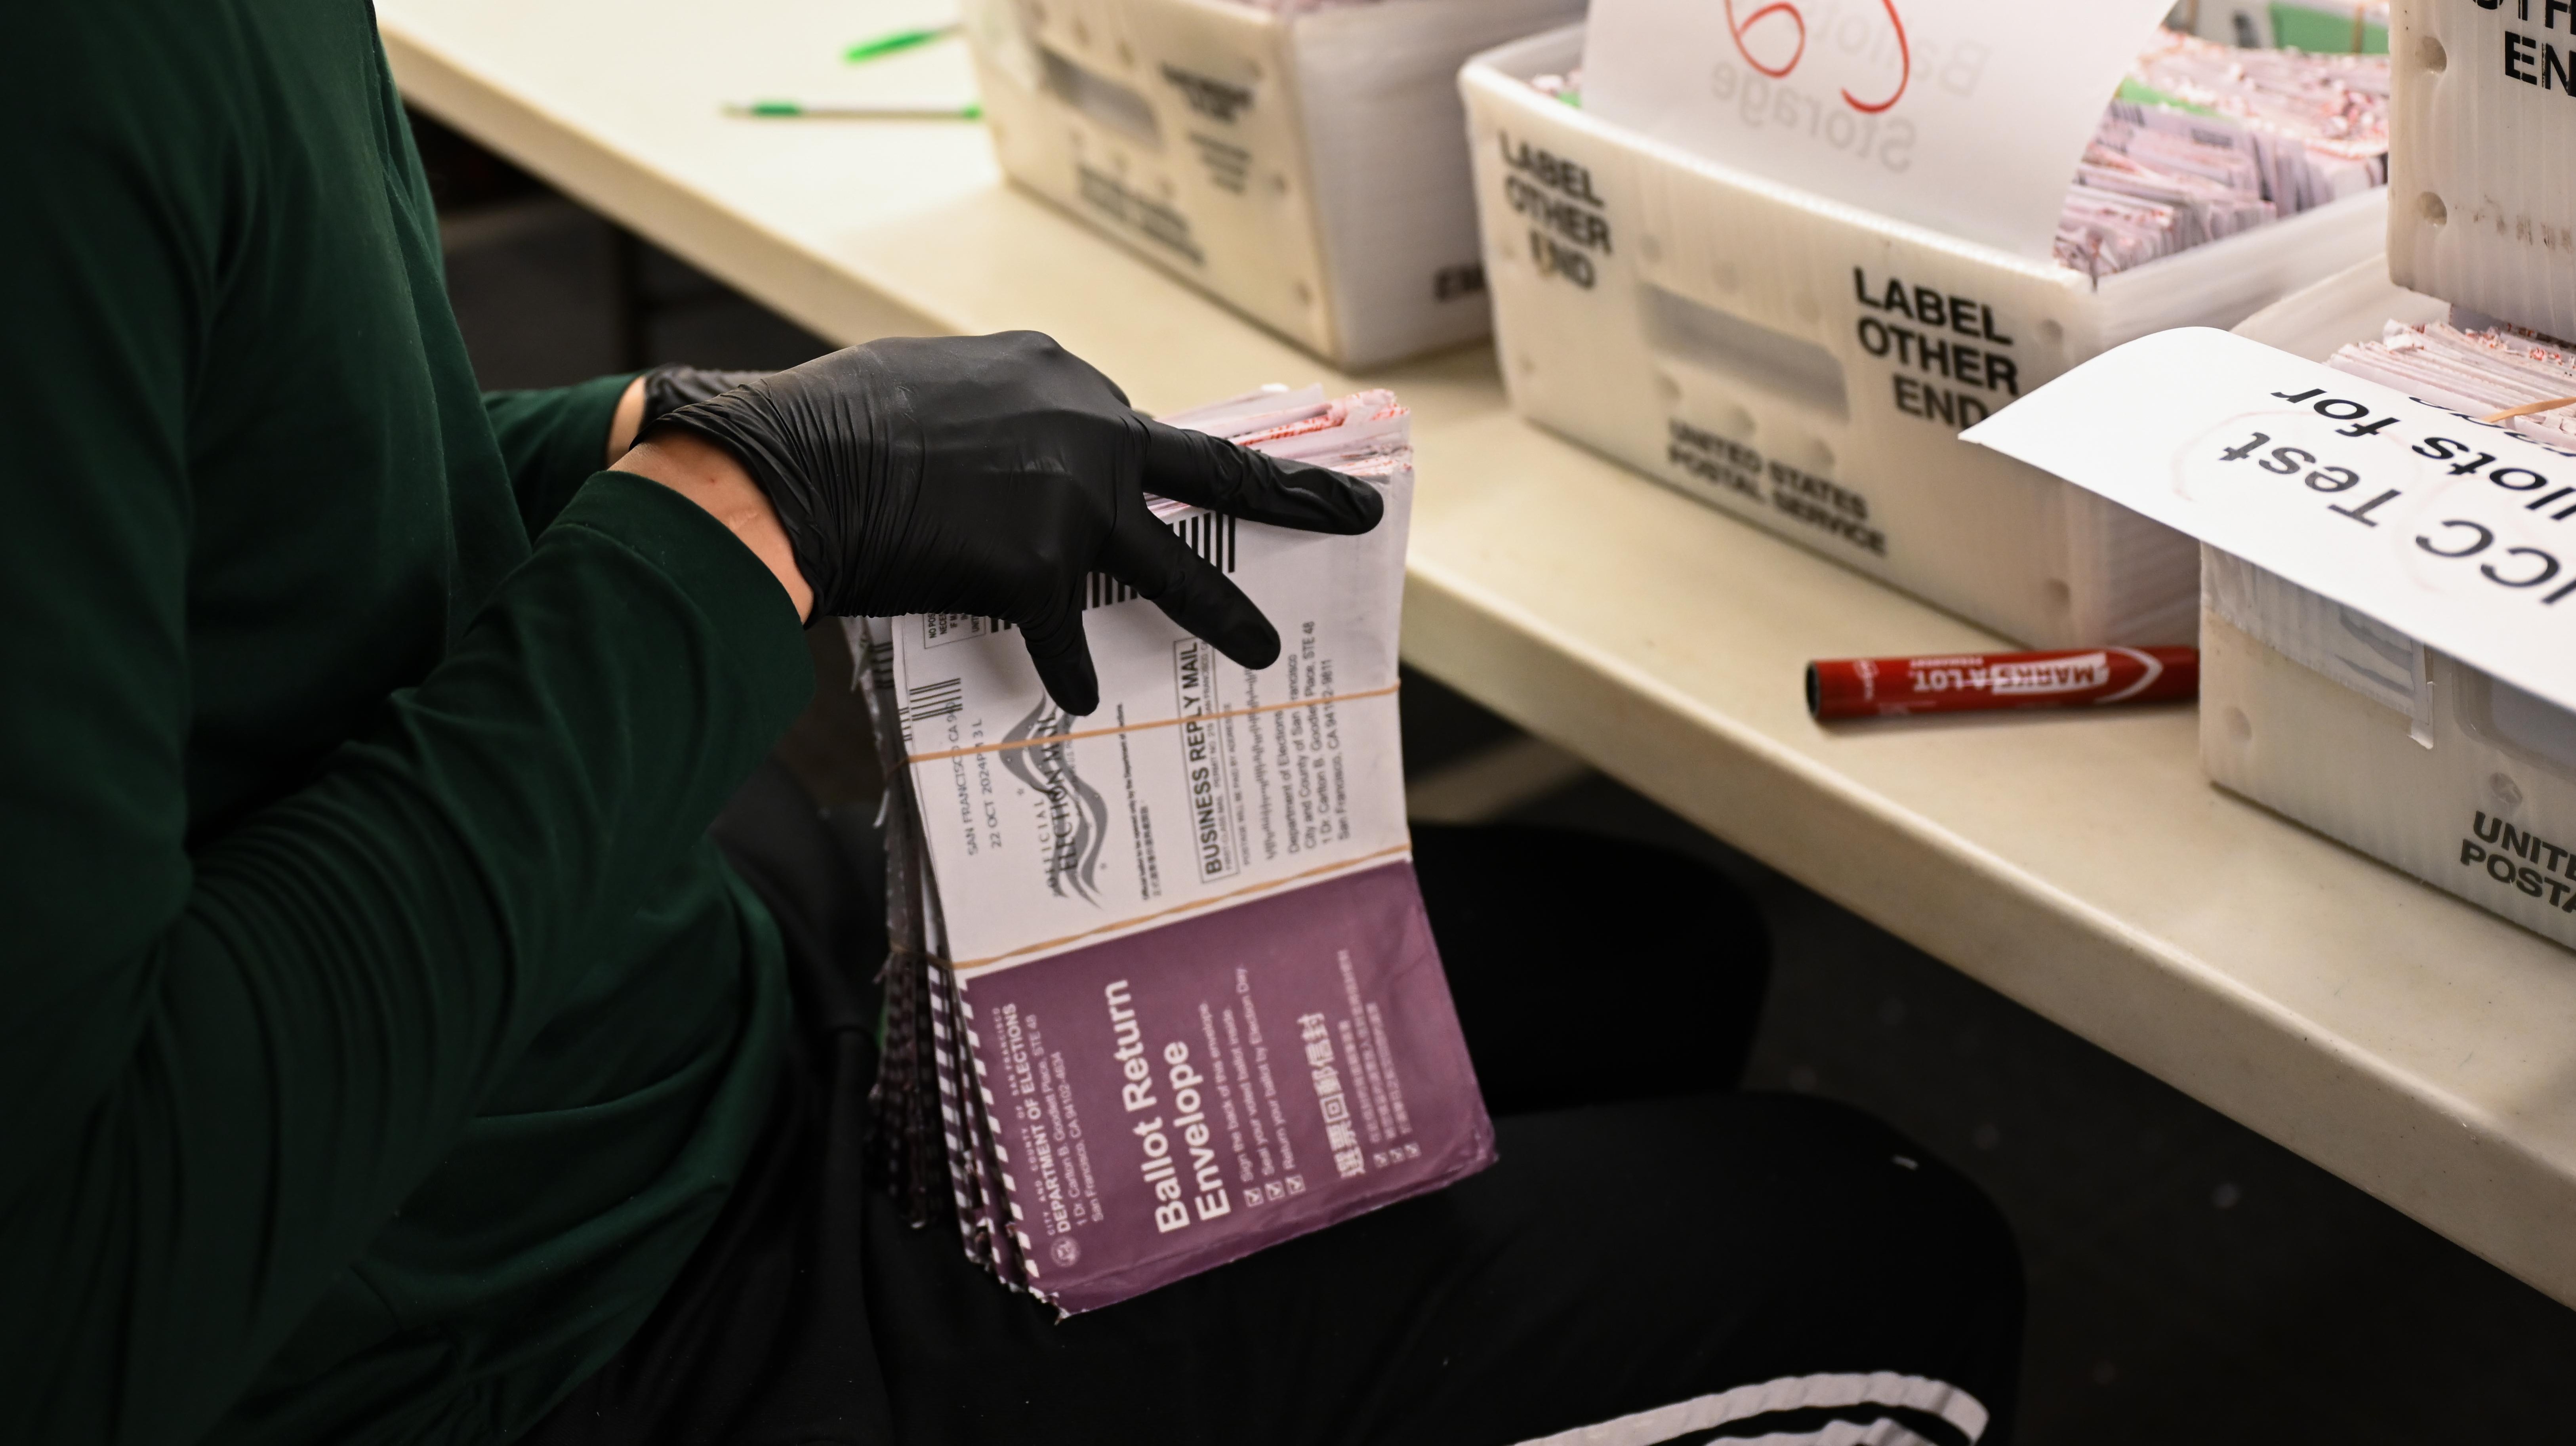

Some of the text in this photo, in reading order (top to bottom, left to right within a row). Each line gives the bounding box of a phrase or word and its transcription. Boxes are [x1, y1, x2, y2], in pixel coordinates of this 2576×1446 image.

[1499, 131, 1604, 206] LABEL
[1504, 176, 1611, 255] OTHER
[1853, 267, 2014, 345] LABEL
[1857, 319, 2019, 395] OTHER
[1893, 374, 1989, 429] END
[2271, 389, 2400, 437] for
[1669, 421, 1867, 520] UNITED STATES
[2219, 431, 2402, 527] Test
[1667, 443, 1886, 556] POSTAL SERVICE
[1302, 621, 1314, 634] 48
[1302, 637, 1316, 659] STE
[1321, 660, 1337, 726] 9412-9811
[1912, 665, 2094, 692] MARKS A LOT
[947, 725, 959, 740] CA
[973, 729, 983, 738] 3
[1327, 730, 1339, 749] CA
[1180, 643, 1222, 874] BUSINESS REPLY MAIL
[1287, 654, 1318, 848] City and County of San rancisco
[1274, 711, 1299, 852] Department of Elections
[1316, 772, 1328, 811] Carlton
[986, 800, 996, 826] OCT
[1043, 766, 1078, 871] ELECTION
[1336, 817, 1350, 839] San
[965, 828, 978, 854] SAN
[991, 832, 1001, 848] 22
[1035, 798, 1056, 888] OFFICIAL
[1024, 1013, 1039, 1030] 48
[1239, 995, 1262, 1044] Election
[991, 1007, 1014, 1069] FRANCISCO
[1029, 1032, 1045, 1057] STE
[1253, 1047, 1269, 1061] by
[1211, 1061, 1227, 1083] this
[1231, 1047, 1249, 1080] ballot
[1258, 1063, 1276, 1096] ballot
[1007, 1075, 1019, 1095] SAN
[1216, 1084, 1231, 1098] of
[1241, 1082, 1258, 1115] voted
[1296, 1009, 1367, 1180] 選票回郵信封
[1001, 1003, 1072, 1232] DEPARTMENT OF ELECTIONS
[1044, 1094, 1066, 1141] Goodlett
[1104, 979, 1189, 1234] Ballot Return
[1221, 1099, 1239, 1129] back
[1268, 1097, 1285, 1125] your
[1068, 1119, 1081, 1139] CA
[1163, 1041, 1230, 1221] Envelope
[1229, 1131, 1245, 1152] the
[1251, 1117, 1268, 1145] your
[1021, 1128, 1038, 1170] COUNTY
[1258, 1147, 1275, 1176] Seal
[1274, 1128, 1296, 1170] Return
[1061, 1158, 1080, 1197] Carlton
[1235, 1153, 1256, 1183] Sign
[1035, 1180, 1046, 1201] AND
[1043, 1211, 1055, 1236] CITY
[1089, 1198, 1104, 1221] San
